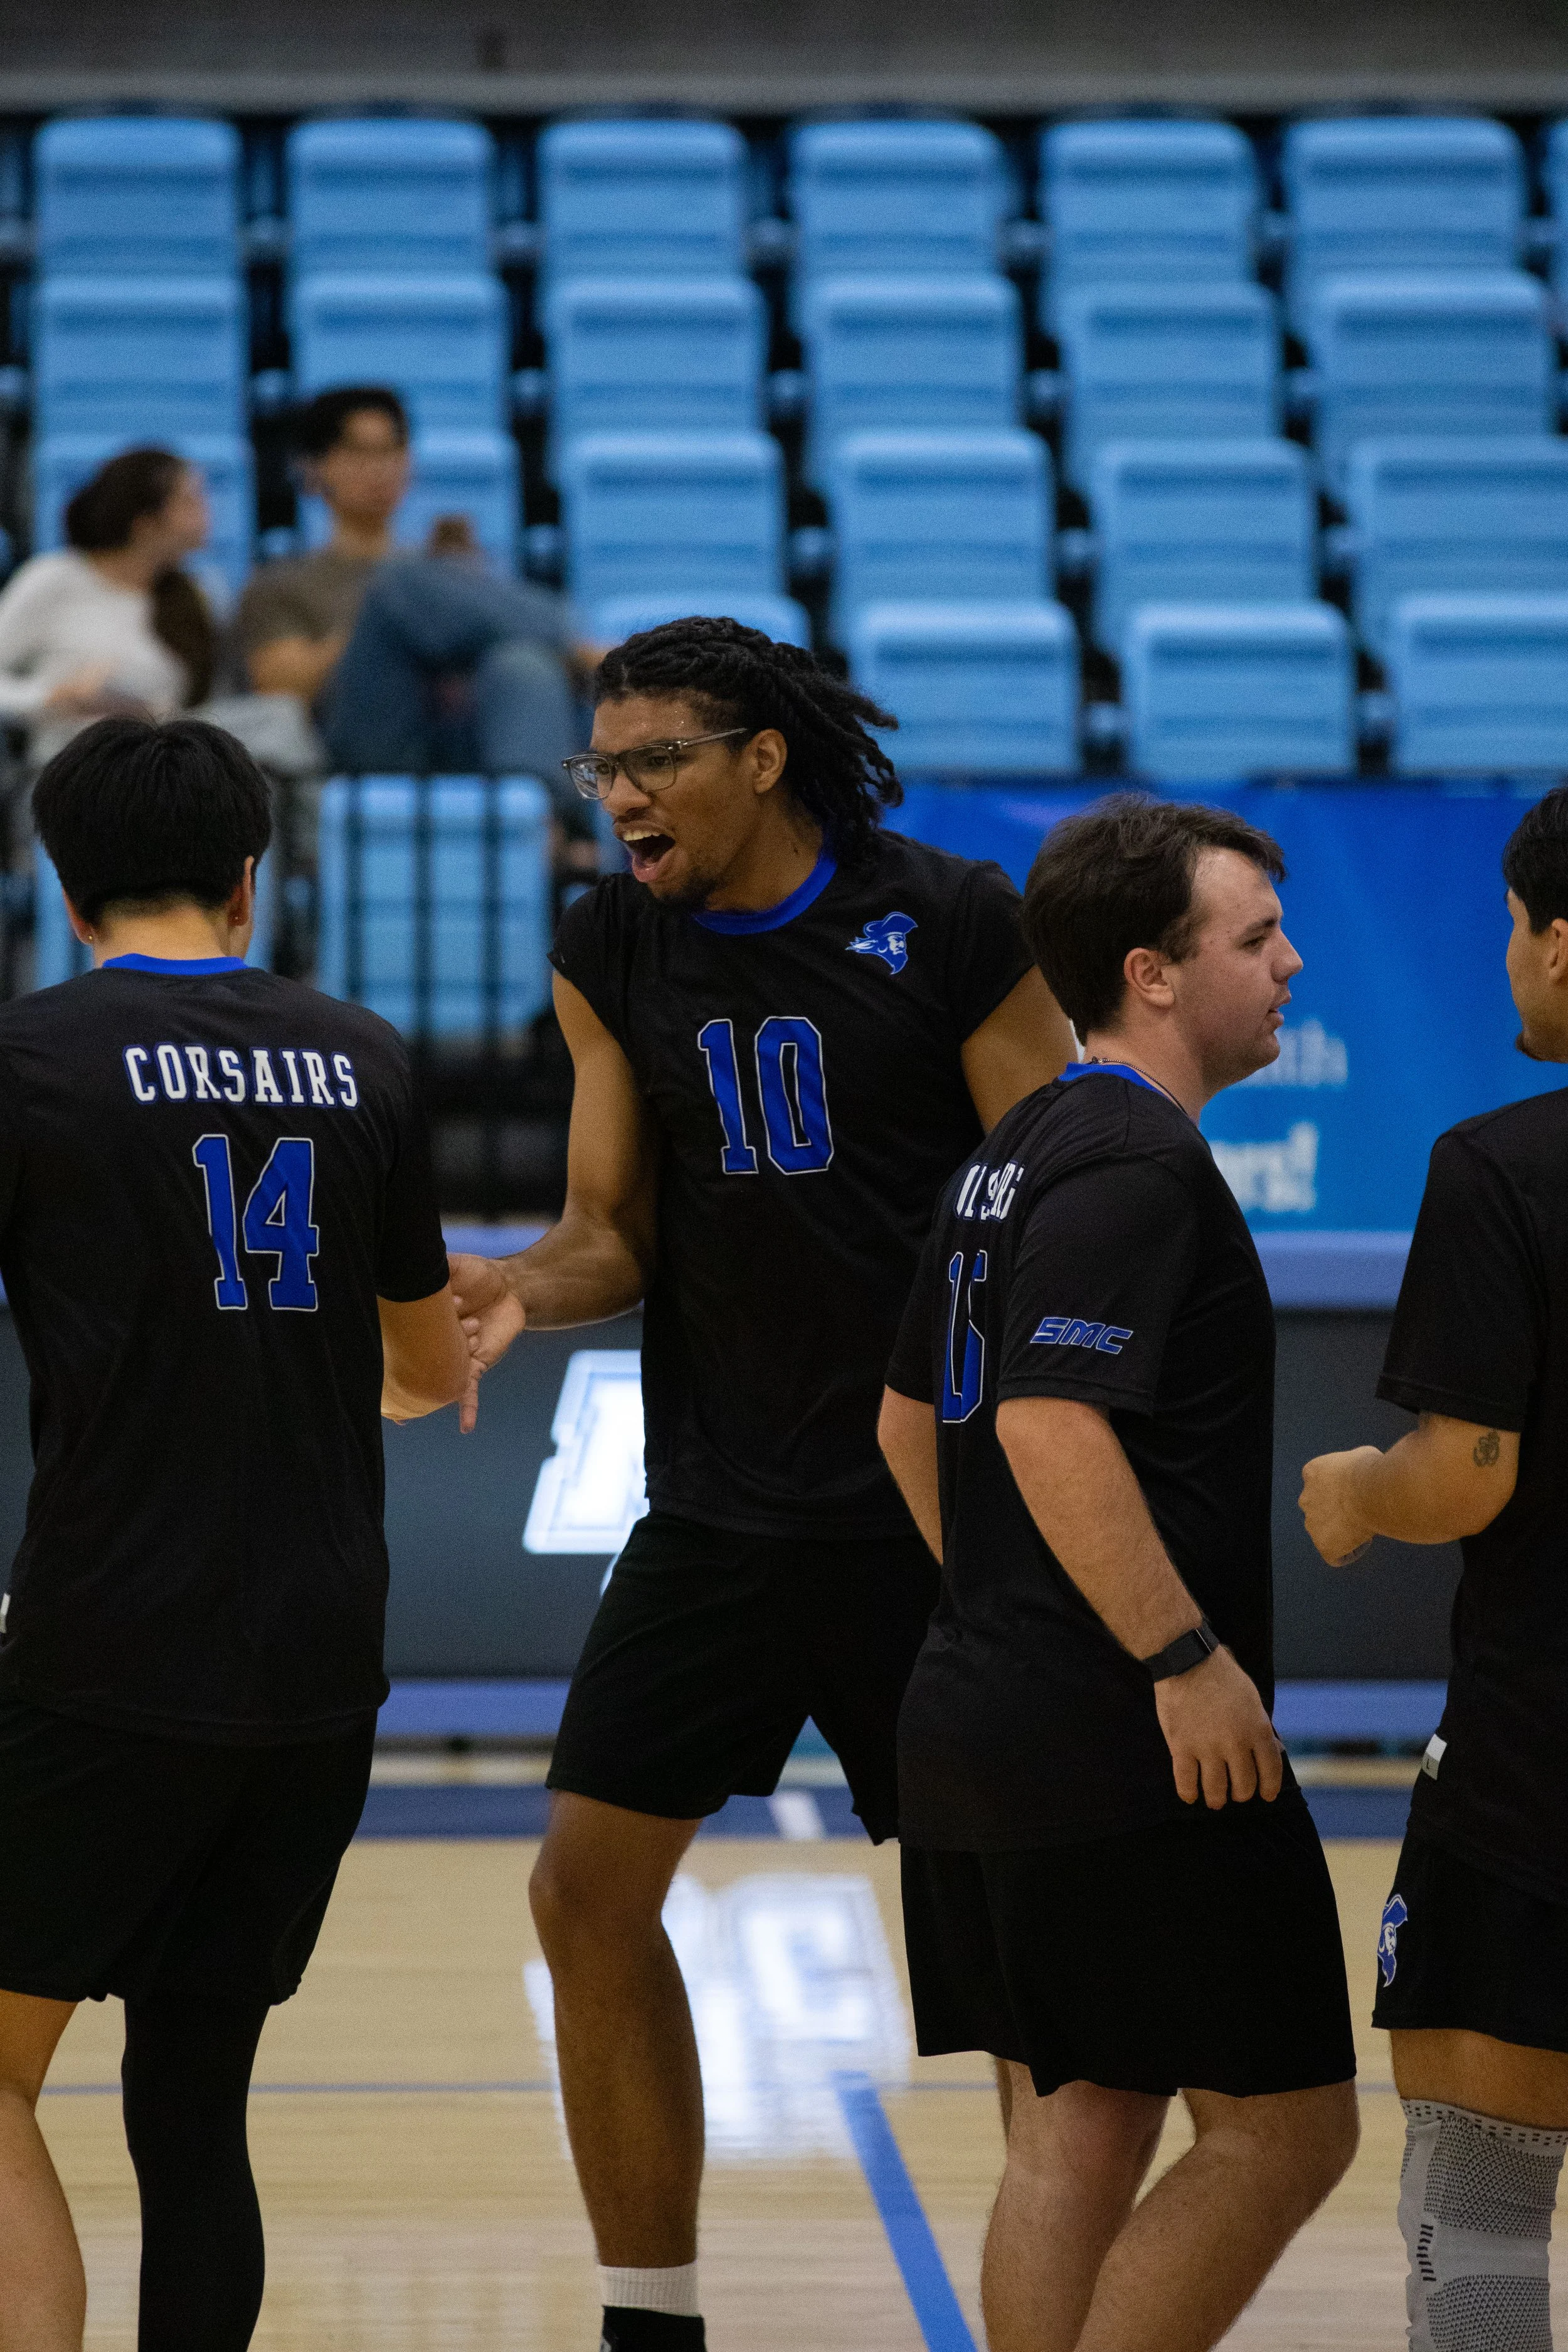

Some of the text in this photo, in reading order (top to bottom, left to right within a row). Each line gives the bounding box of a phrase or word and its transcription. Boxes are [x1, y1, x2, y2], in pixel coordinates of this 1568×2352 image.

[124, 1043, 359, 1109] CORSAIRS
[697, 1015, 834, 1175] 10
[192, 1134, 319, 1311] 14
[1030, 1316, 1133, 1355] SMC
